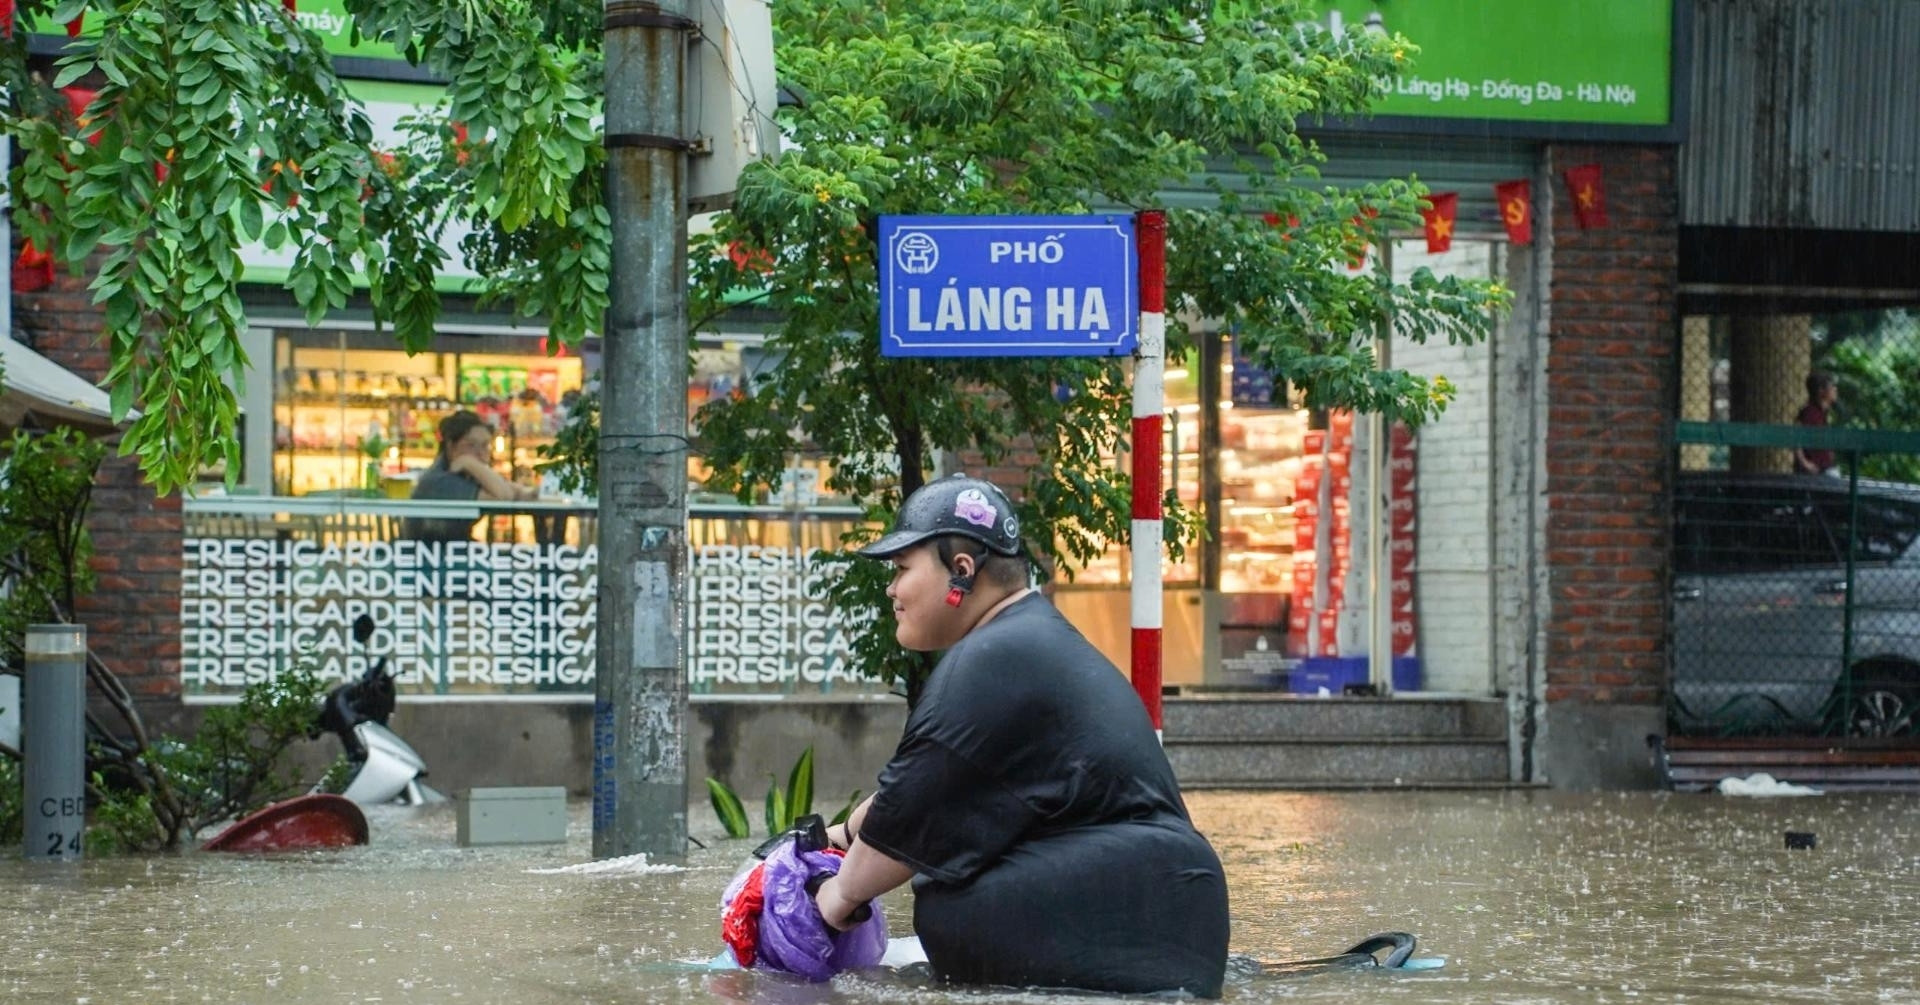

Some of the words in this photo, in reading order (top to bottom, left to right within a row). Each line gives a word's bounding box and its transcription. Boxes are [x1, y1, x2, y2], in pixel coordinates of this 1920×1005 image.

[296, 8, 345, 36] máy
[1397, 75, 1442, 101] Láng
[1445, 77, 1470, 101] Hạ
[1536, 81, 1562, 101] Đa
[990, 233, 1066, 263] PHỐ
[908, 278, 1032, 331] LÁNG
[1046, 287, 1110, 339] HẠ
[182, 539, 440, 568] FRESHGARDEN
[446, 541, 597, 571] FRESHGA
[181, 569, 440, 597] FRESHGARDEN
[446, 571, 597, 598] FRESHGA
[180, 599, 440, 627] FRESHGARDEN
[445, 601, 597, 629] FRESHGA
[445, 628, 596, 656] FRESHGA
[445, 656, 596, 684] FRESHGA
[47, 832, 80, 855] 24
